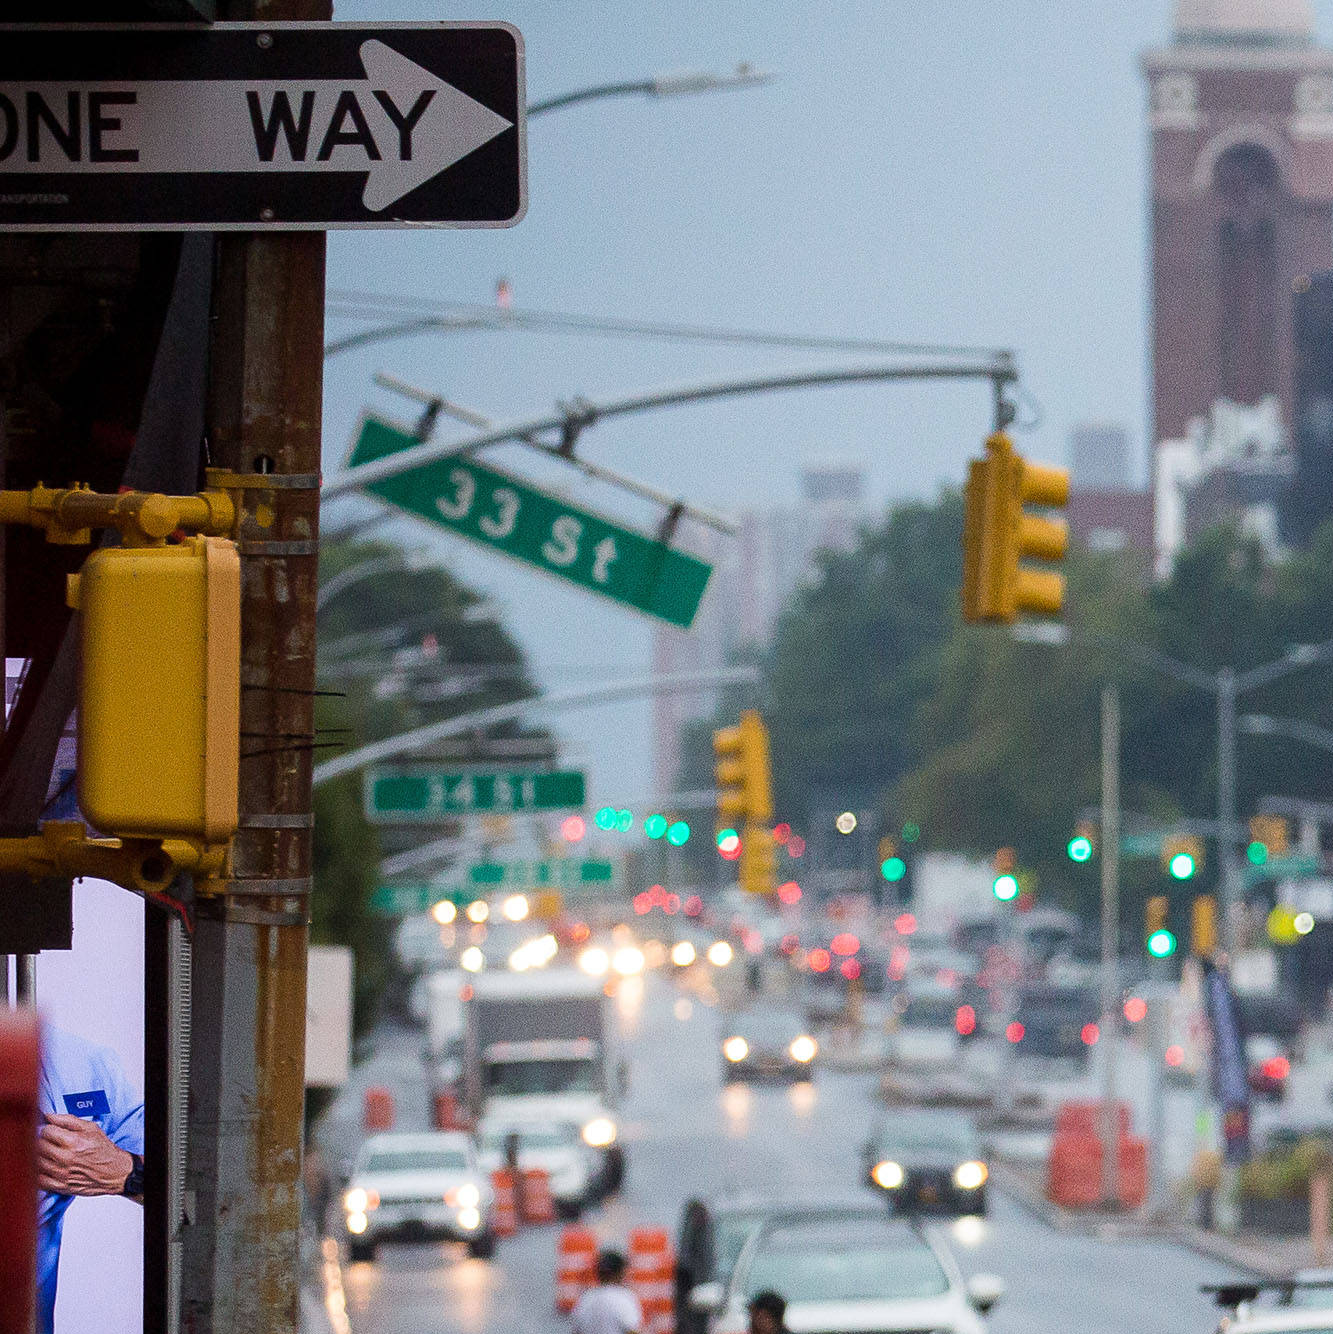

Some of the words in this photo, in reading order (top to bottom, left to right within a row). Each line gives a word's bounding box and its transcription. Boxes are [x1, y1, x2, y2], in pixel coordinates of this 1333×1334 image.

[246, 90, 437, 162] WAY
[435, 468, 522, 539] 33
[540, 515, 618, 584] St
[76, 1100, 95, 1110] GUY
